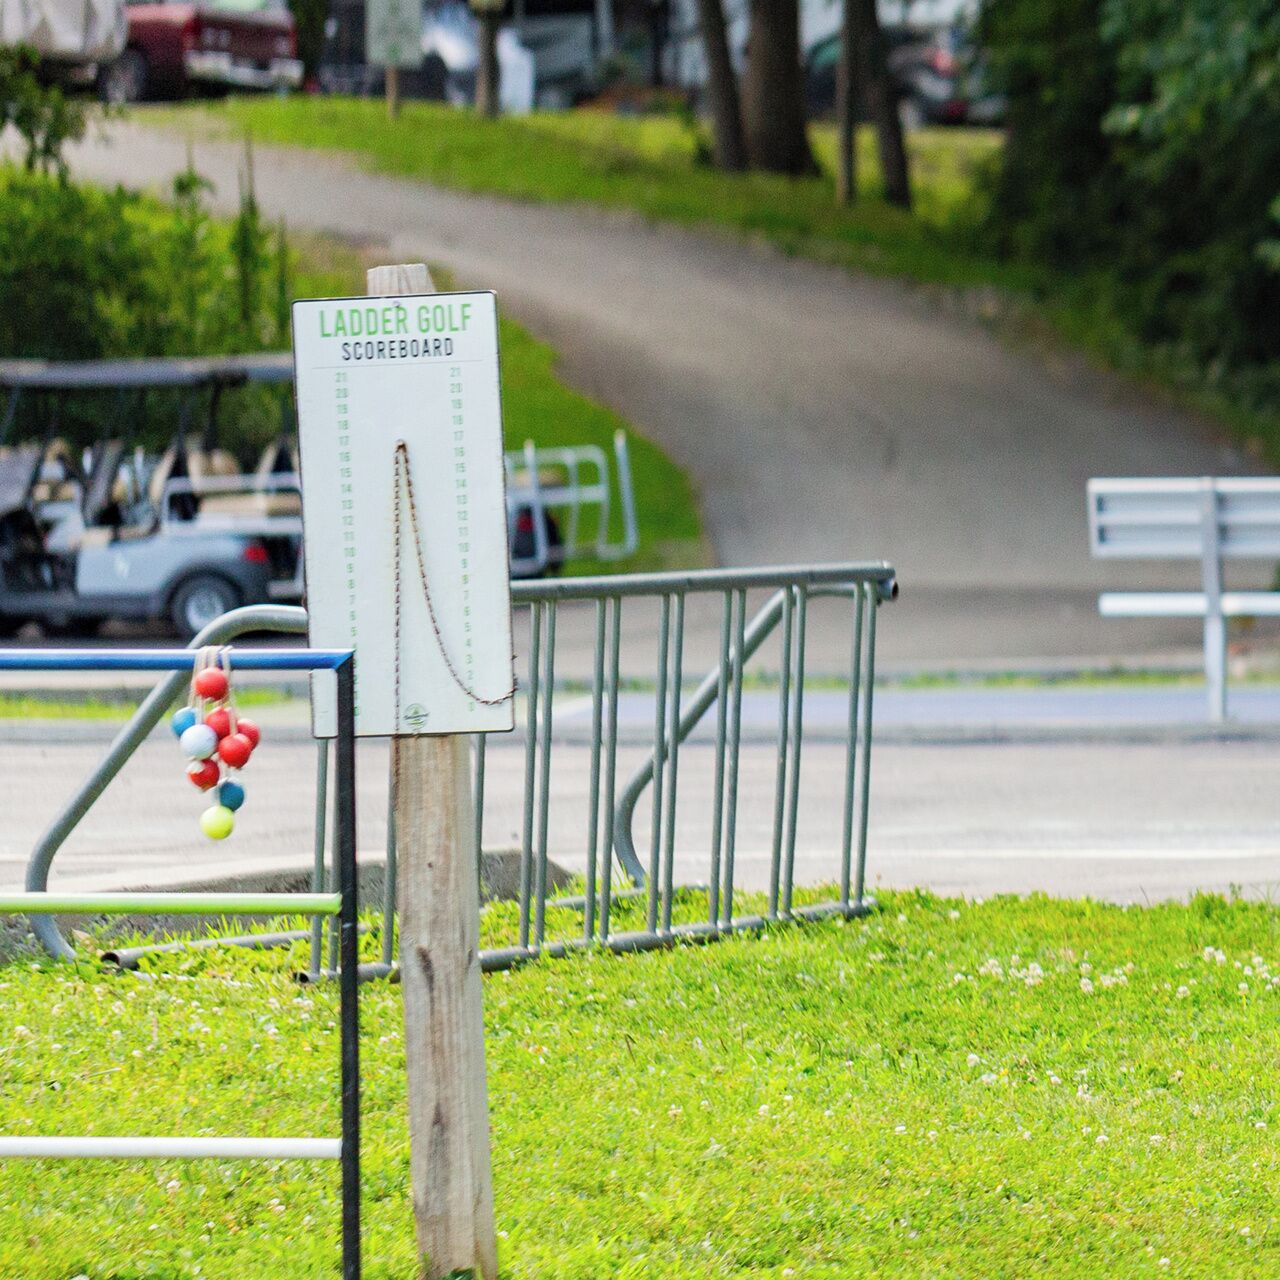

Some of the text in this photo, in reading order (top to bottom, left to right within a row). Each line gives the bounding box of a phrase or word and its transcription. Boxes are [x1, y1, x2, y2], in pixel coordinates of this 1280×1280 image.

[319, 303, 472, 338] LADDER GOLF
[341, 337, 454, 361] SCOREBOARD
